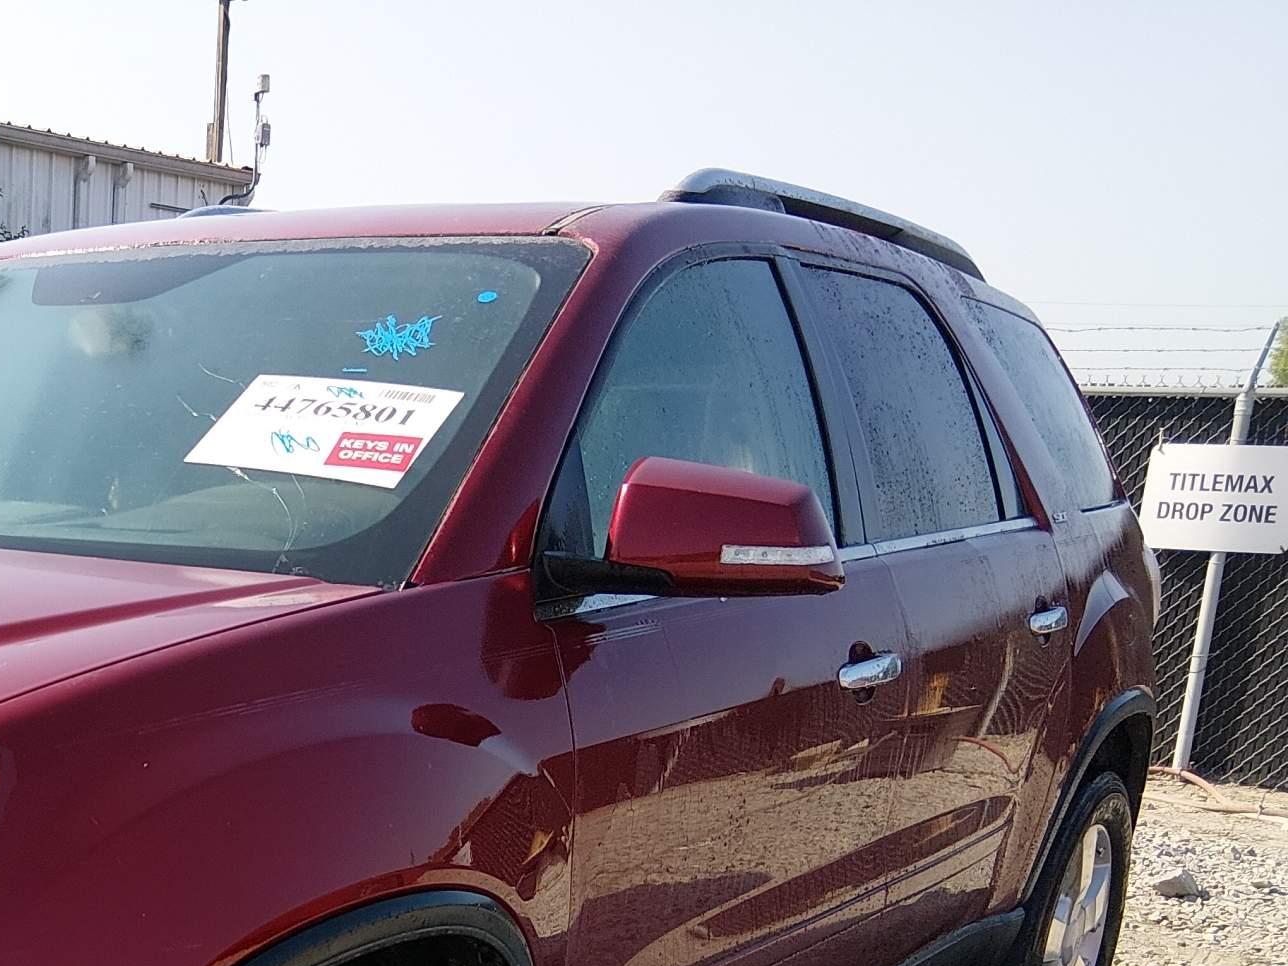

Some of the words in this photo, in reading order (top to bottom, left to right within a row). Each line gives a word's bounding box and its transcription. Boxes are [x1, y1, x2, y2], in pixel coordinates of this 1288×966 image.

[254, 396, 416, 426] 44765801
[338, 449, 404, 465] OFFICE
[339, 438, 390, 451] KEYS
[393, 442, 415, 454] IN
[1169, 472, 1275, 494] TITLEMAX
[1156, 501, 1214, 521] DROP
[1218, 503, 1278, 524] ZONE
